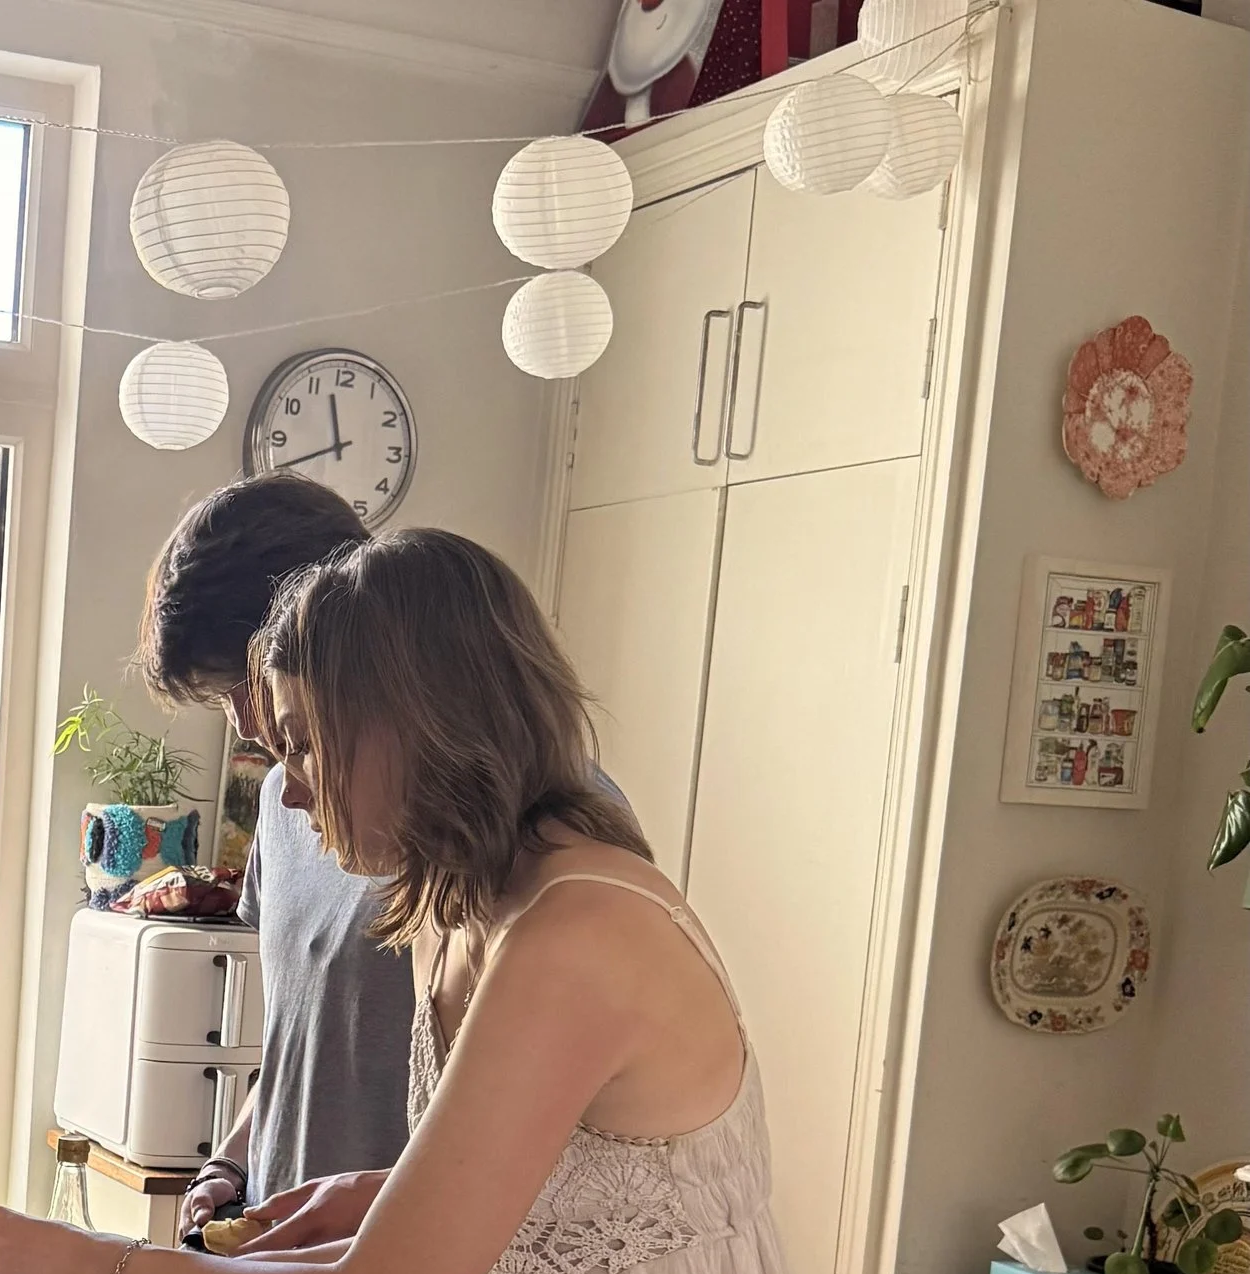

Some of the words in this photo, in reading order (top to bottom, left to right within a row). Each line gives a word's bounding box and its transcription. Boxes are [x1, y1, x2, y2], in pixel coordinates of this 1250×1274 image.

[308, 376, 320, 395] 11
[335, 369, 356, 389] 12
[370, 382, 375, 400] 1
[285, 397, 300, 416] 10
[381, 410, 397, 428] 2
[271, 430, 287, 448] 9
[386, 446, 402, 464] 3
[374, 477, 390, 495] 4
[353, 500, 368, 517] 5
